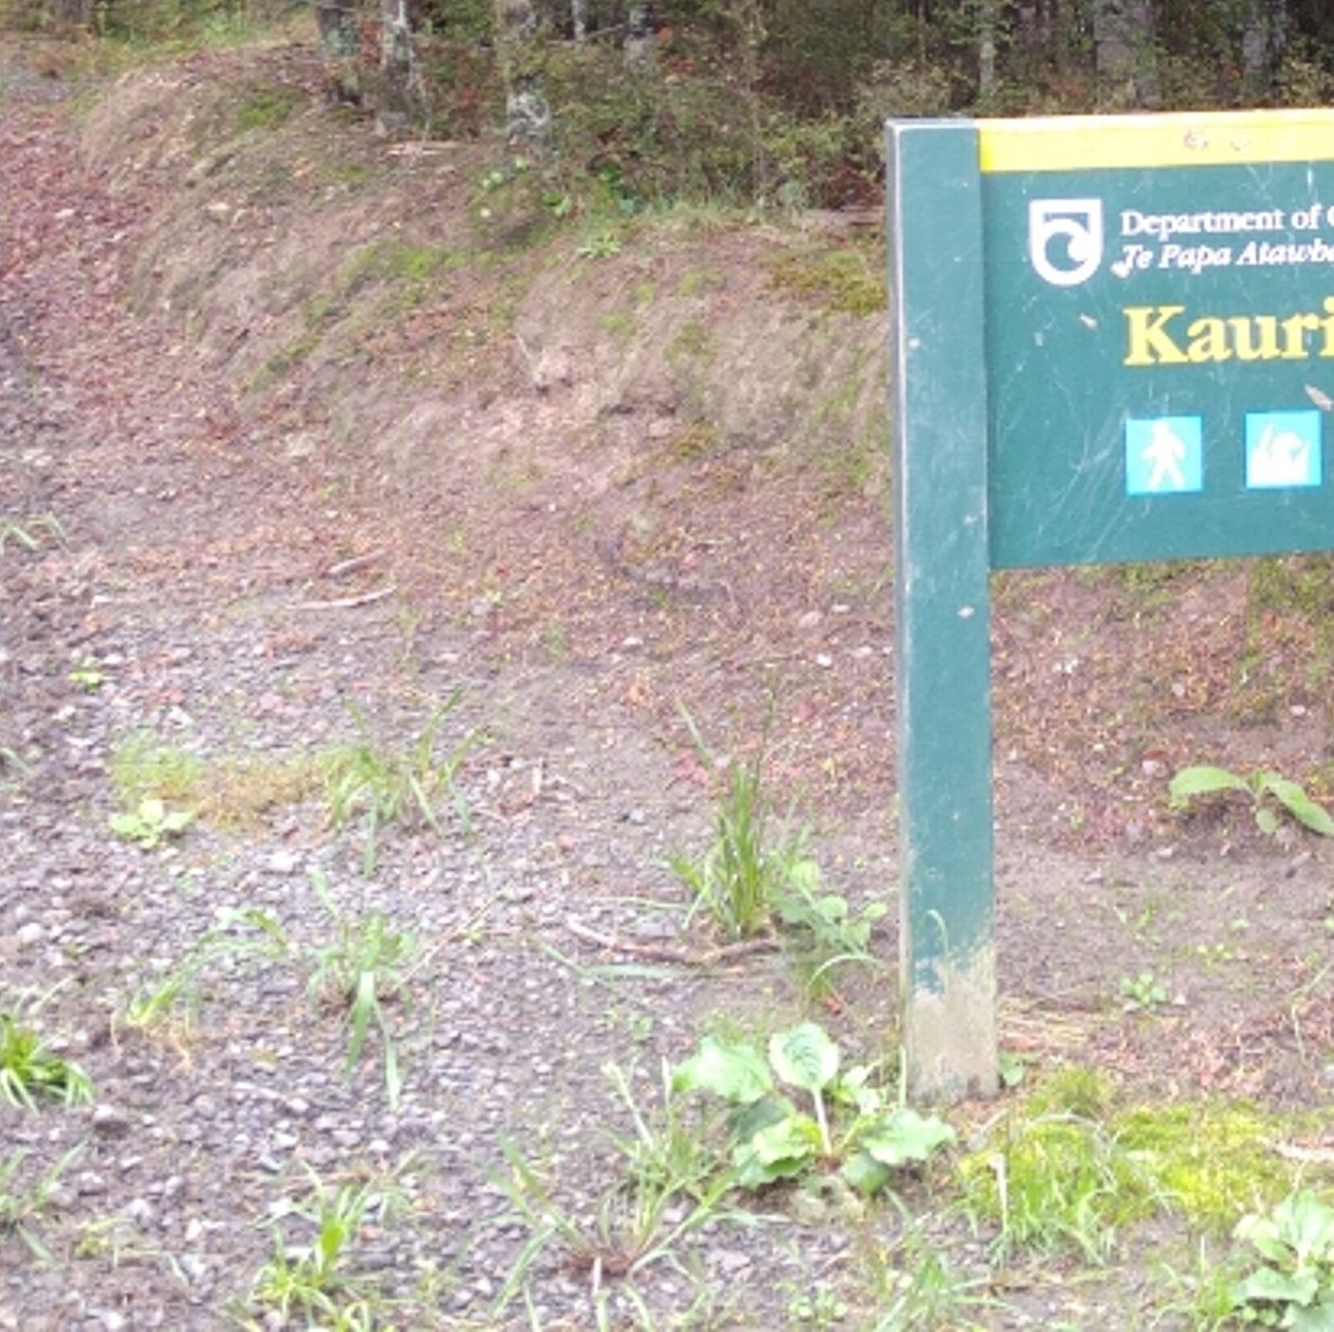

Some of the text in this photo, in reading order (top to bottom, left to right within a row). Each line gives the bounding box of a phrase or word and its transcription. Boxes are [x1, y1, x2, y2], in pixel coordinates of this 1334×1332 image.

[1120, 206, 1284, 239] Department
[1291, 201, 1320, 229] of
[1121, 243, 1153, 269] Te
[1158, 242, 1232, 273] Papa
